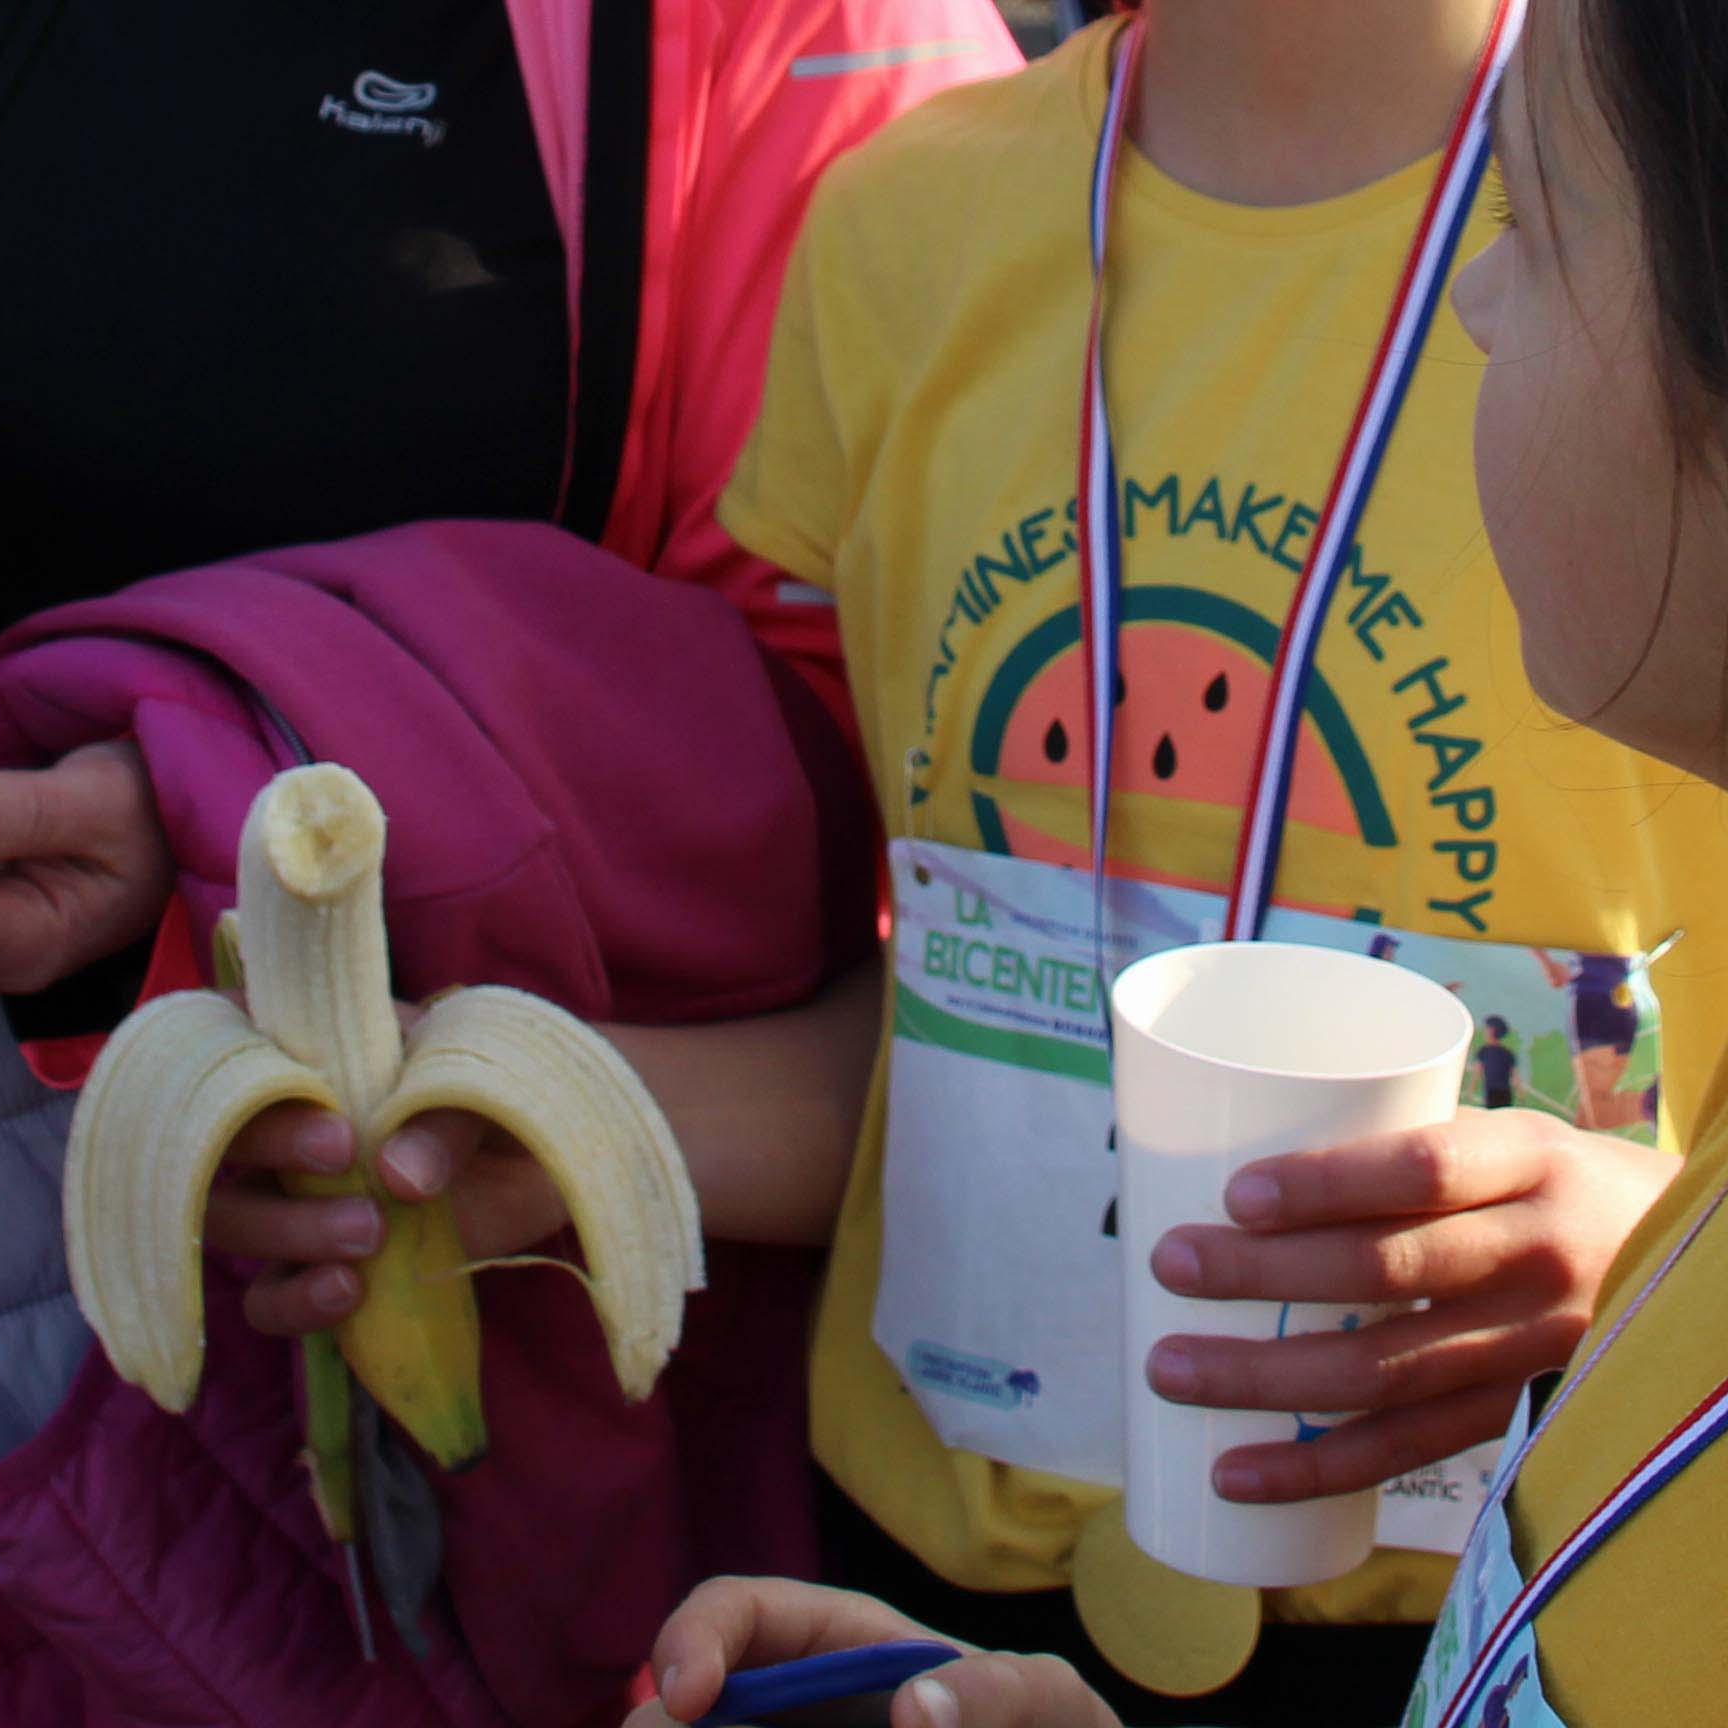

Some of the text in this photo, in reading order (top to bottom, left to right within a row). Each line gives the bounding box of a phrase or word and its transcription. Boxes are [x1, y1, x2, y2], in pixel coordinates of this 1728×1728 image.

[1124, 474, 1319, 572] MAKE
[1341, 543, 1424, 661] ME
[1393, 657, 1498, 933] HAPPY
[955, 887, 994, 931] LA
